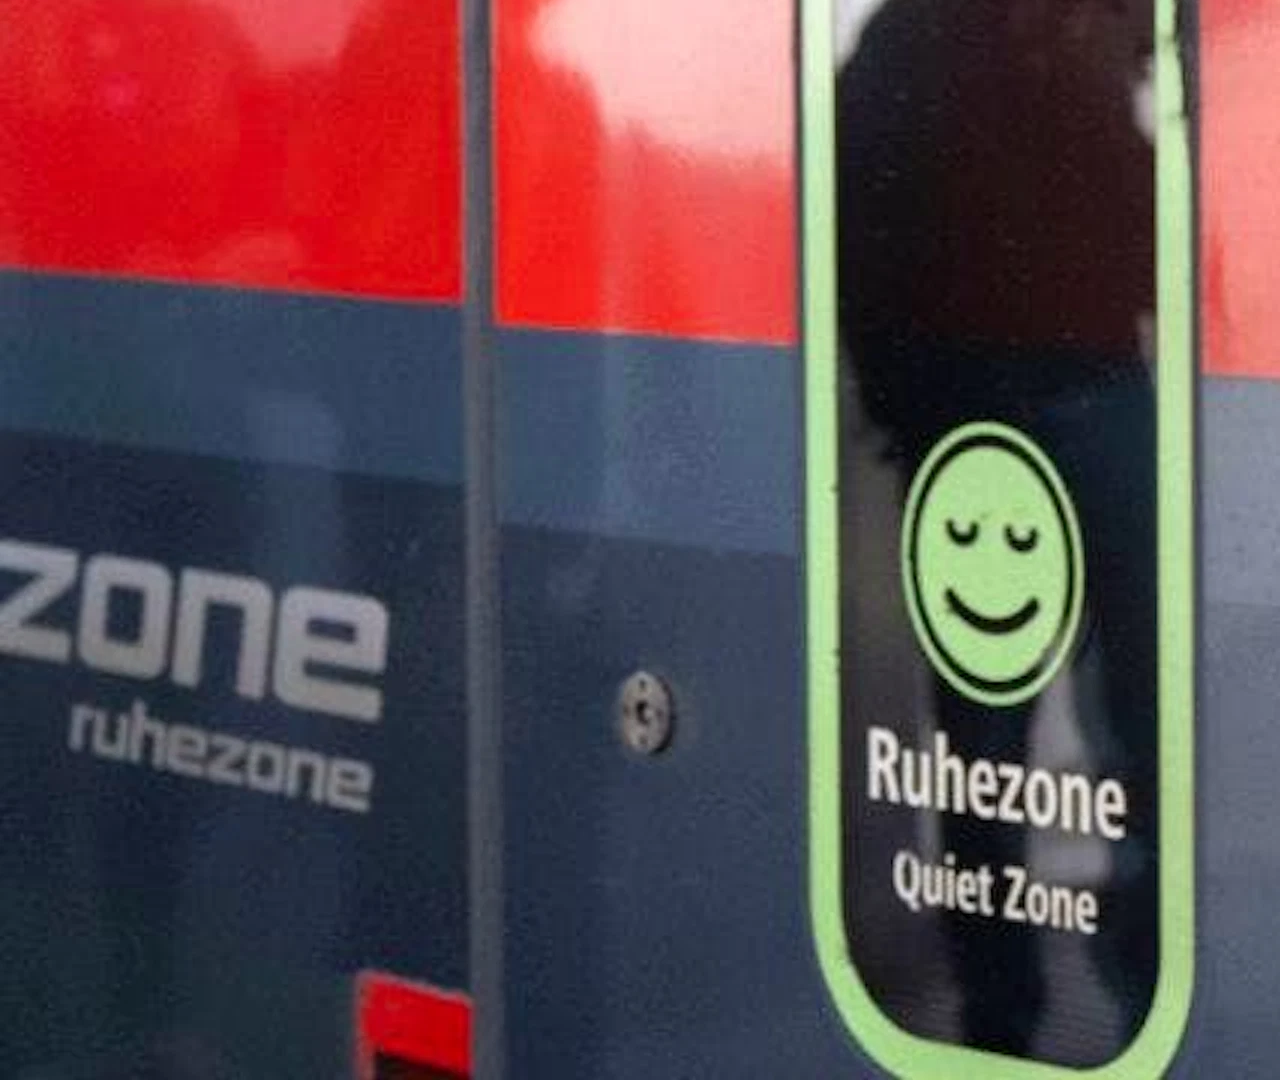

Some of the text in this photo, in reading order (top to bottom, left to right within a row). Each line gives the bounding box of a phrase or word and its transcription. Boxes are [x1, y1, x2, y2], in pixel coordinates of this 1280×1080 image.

[0, 540, 389, 721] zone
[67, 698, 374, 813] ruhezone
[866, 726, 1128, 840] Ruhezone
[892, 850, 1098, 934] Quiet Zone
